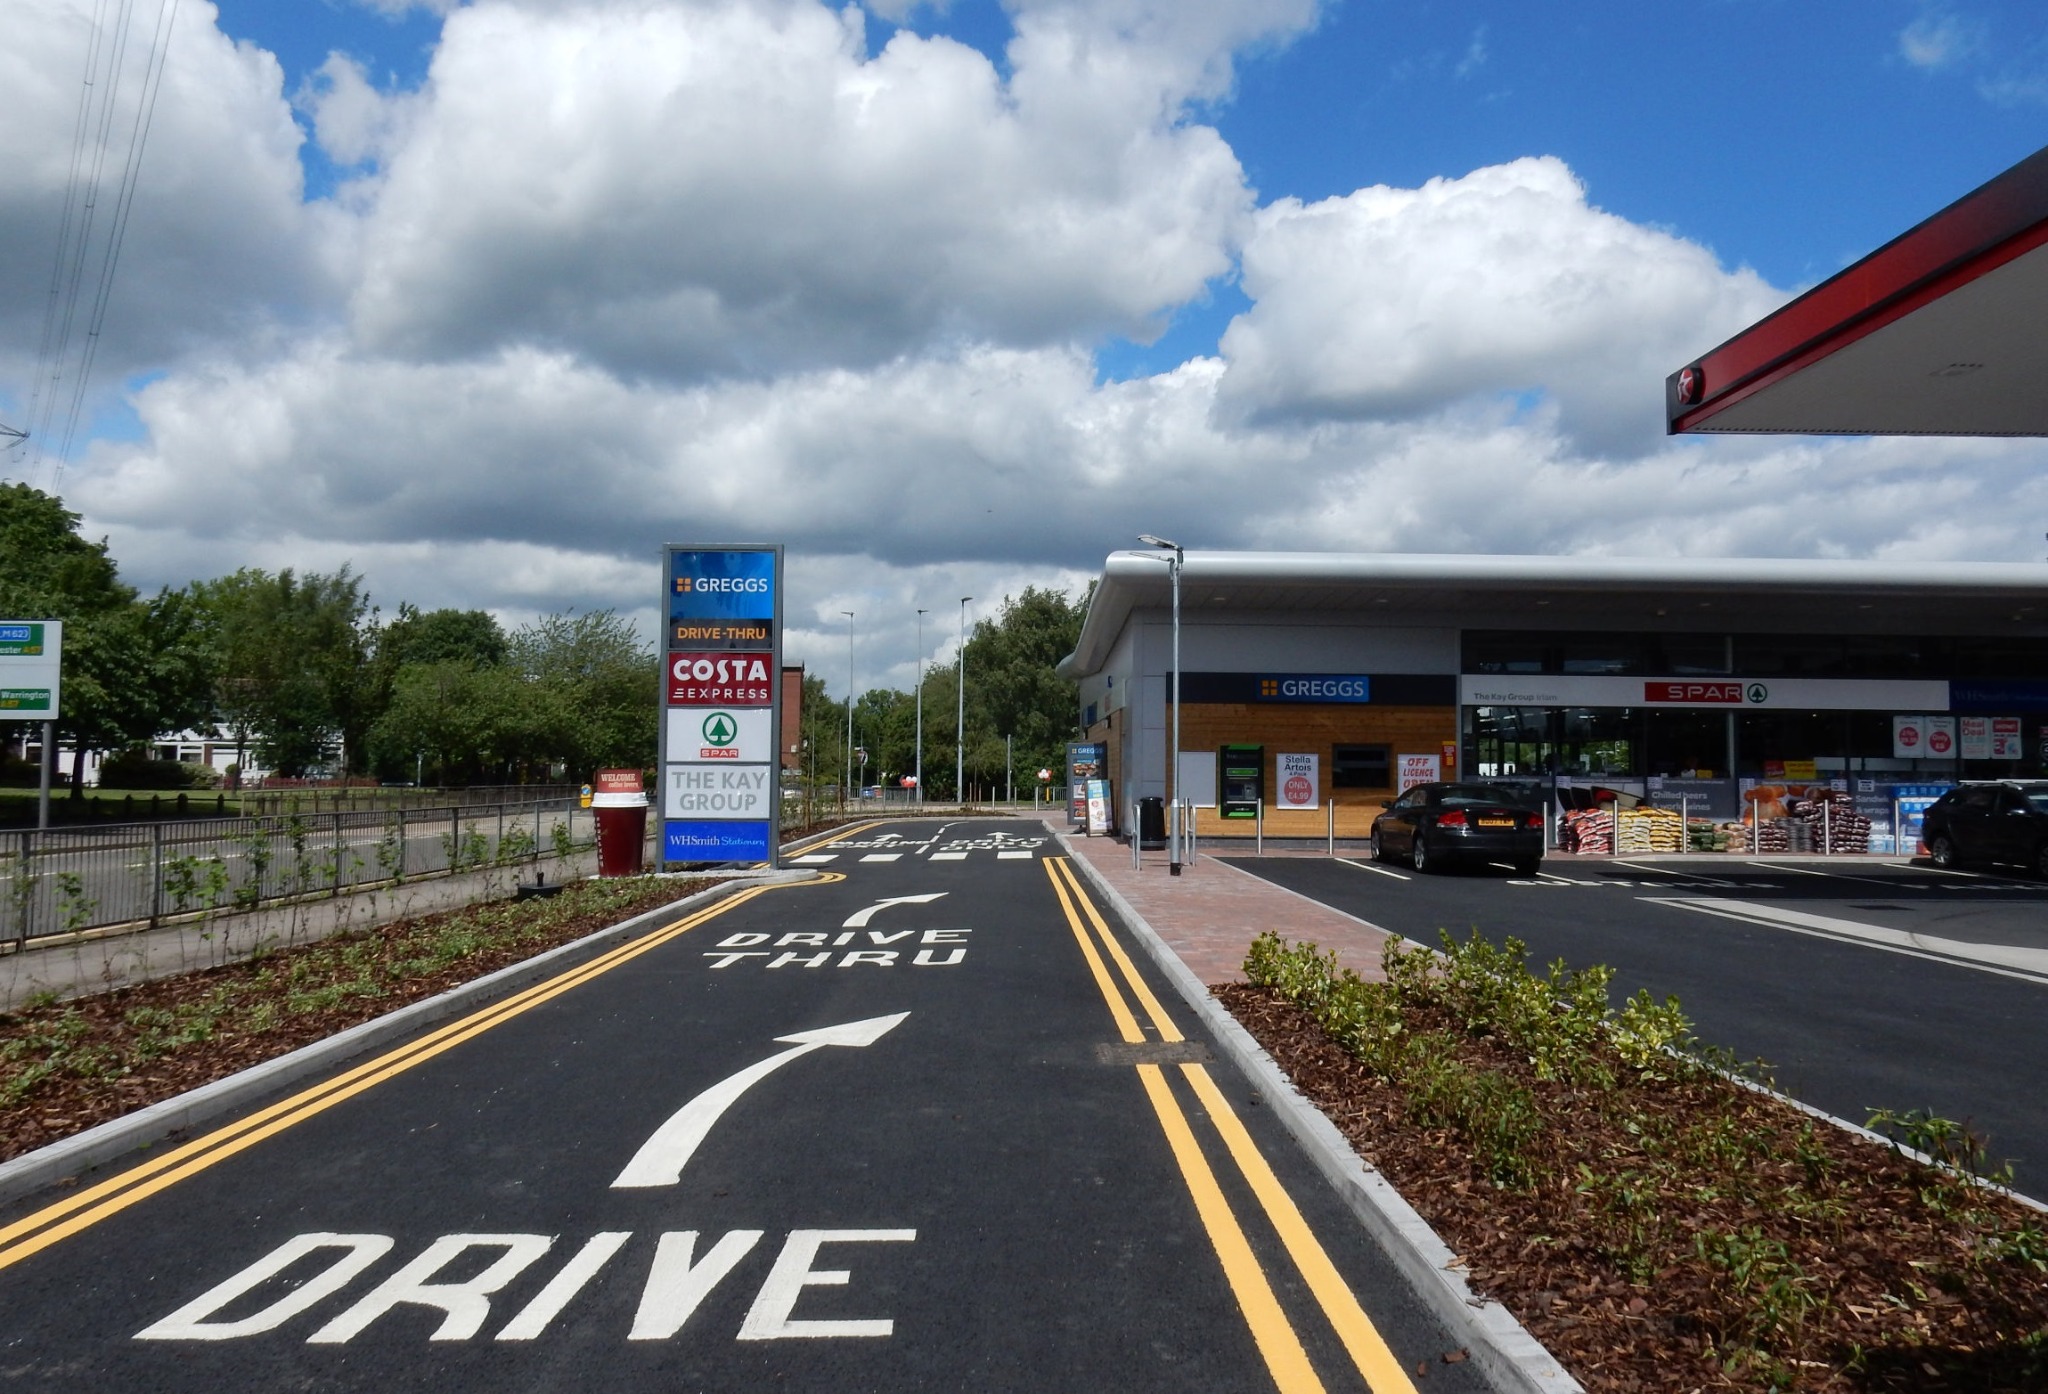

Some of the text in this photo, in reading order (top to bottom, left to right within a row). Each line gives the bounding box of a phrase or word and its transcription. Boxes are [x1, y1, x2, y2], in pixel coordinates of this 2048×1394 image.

[695, 578, 768, 592] GREGGS
[677, 627, 766, 640] DRIVE-THRU
[673, 659, 768, 684] COSTA
[687, 688, 768, 699] EXPRESS
[1282, 679, 1364, 697] GREGGS
[1668, 685, 1741, 699] SPAR
[1, 691, 49, 700] Warrington
[1492, 693, 1506, 702] Kay
[1508, 693, 1534, 702] Group
[701, 749, 738, 757] SPAR
[1285, 755, 1310, 763] Stella
[1407, 757, 1429, 766] OFF
[1284, 763, 1312, 771] Artois
[1403, 768, 1434, 777] LICENCE
[601, 773, 635, 782] WELCOME
[671, 772, 765, 790] THE KAY
[1288, 781, 1309, 789] ONLY
[1651, 791, 1708, 799] Chilled beers
[679, 793, 757, 811] GROUP
[670, 835, 765, 847] WHSmith Stationery
[716, 929, 972, 947] DRIVE
[703, 949, 967, 968] THRU
[131, 1229, 918, 1344] DRIVE
